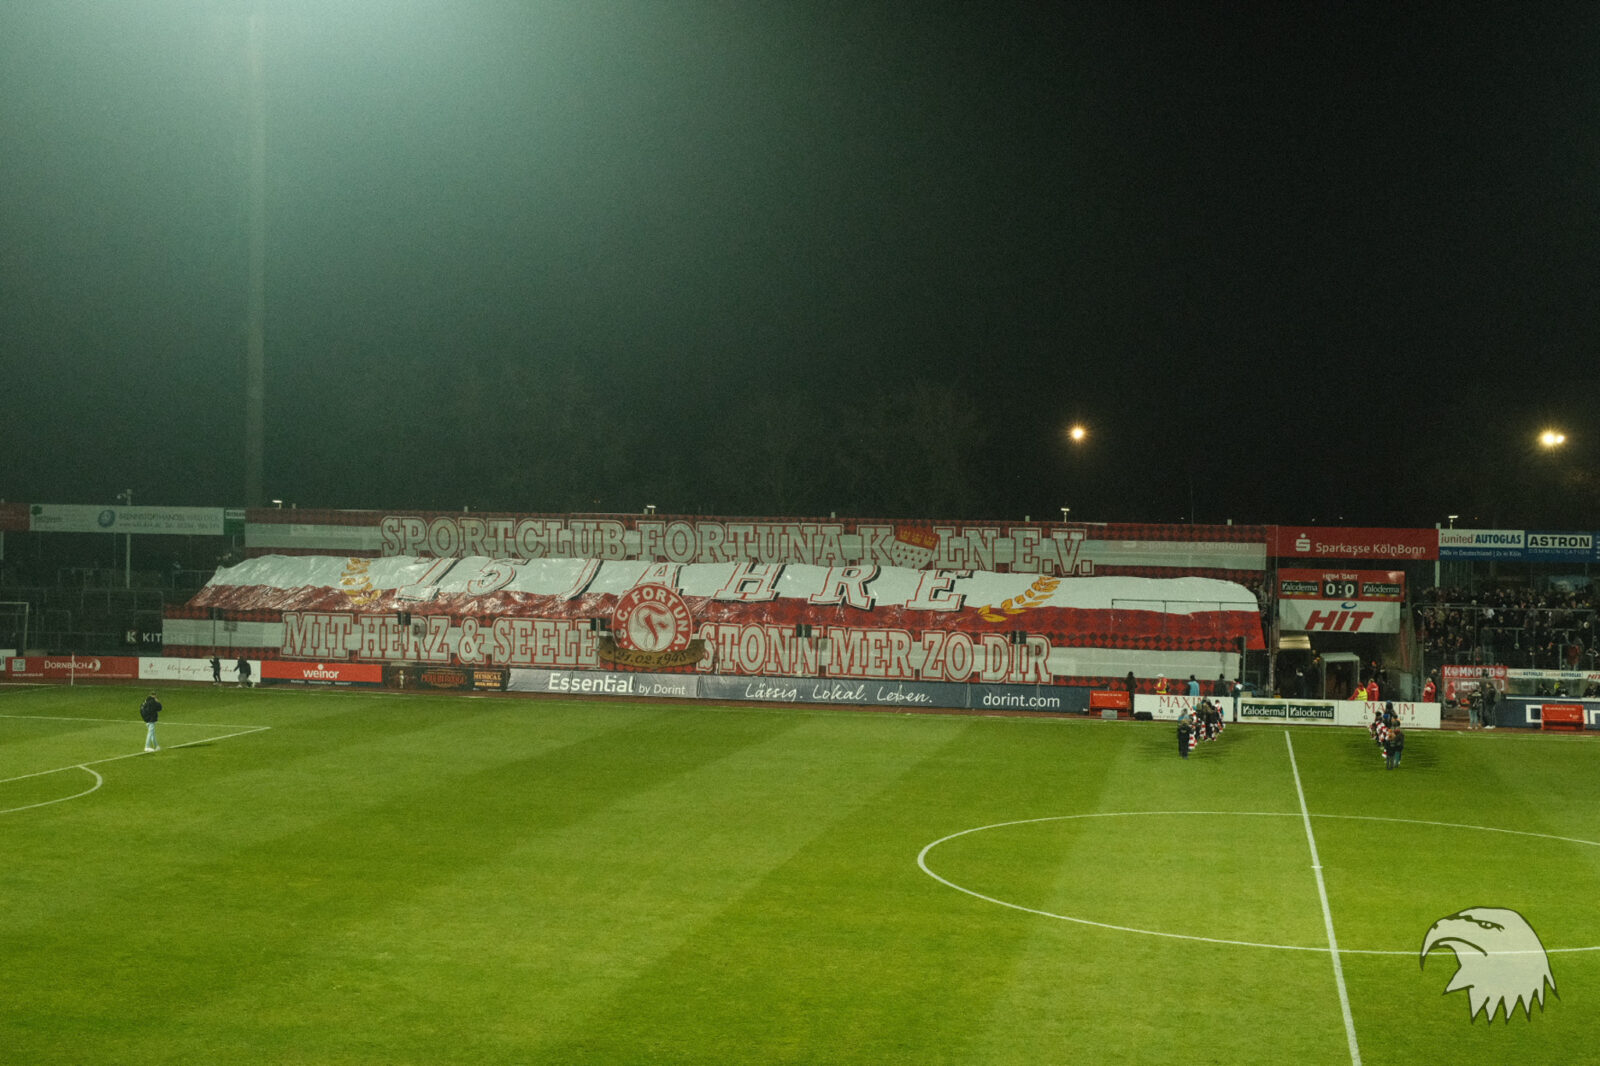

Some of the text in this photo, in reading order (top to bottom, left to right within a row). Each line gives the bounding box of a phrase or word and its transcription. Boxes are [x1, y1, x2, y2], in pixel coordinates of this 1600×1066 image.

[381, 516, 1095, 577] SPORTCLUB FORTUNA KLN E.V.
[1475, 534, 1521, 545] AUTOGLAS
[1529, 536, 1590, 547] ASTRON
[1316, 542, 1426, 555] Sparkasse KölnBonn
[631, 587, 689, 645] FORTUNA
[1304, 610, 1374, 631] HIT
[282, 612, 353, 660] MIT
[357, 613, 451, 663] HERZ
[458, 616, 485, 664] &
[492, 616, 600, 667] SEELE
[827, 626, 915, 680] MER
[921, 630, 975, 682] ZO
[981, 632, 1052, 685] DIR
[303, 663, 340, 679] weinor
[549, 673, 686, 695] Essential by Dorint
[812, 684, 867, 701] Lokal.
[983, 692, 1060, 708] dorint.com
[1364, 702, 1415, 715] MAIM
